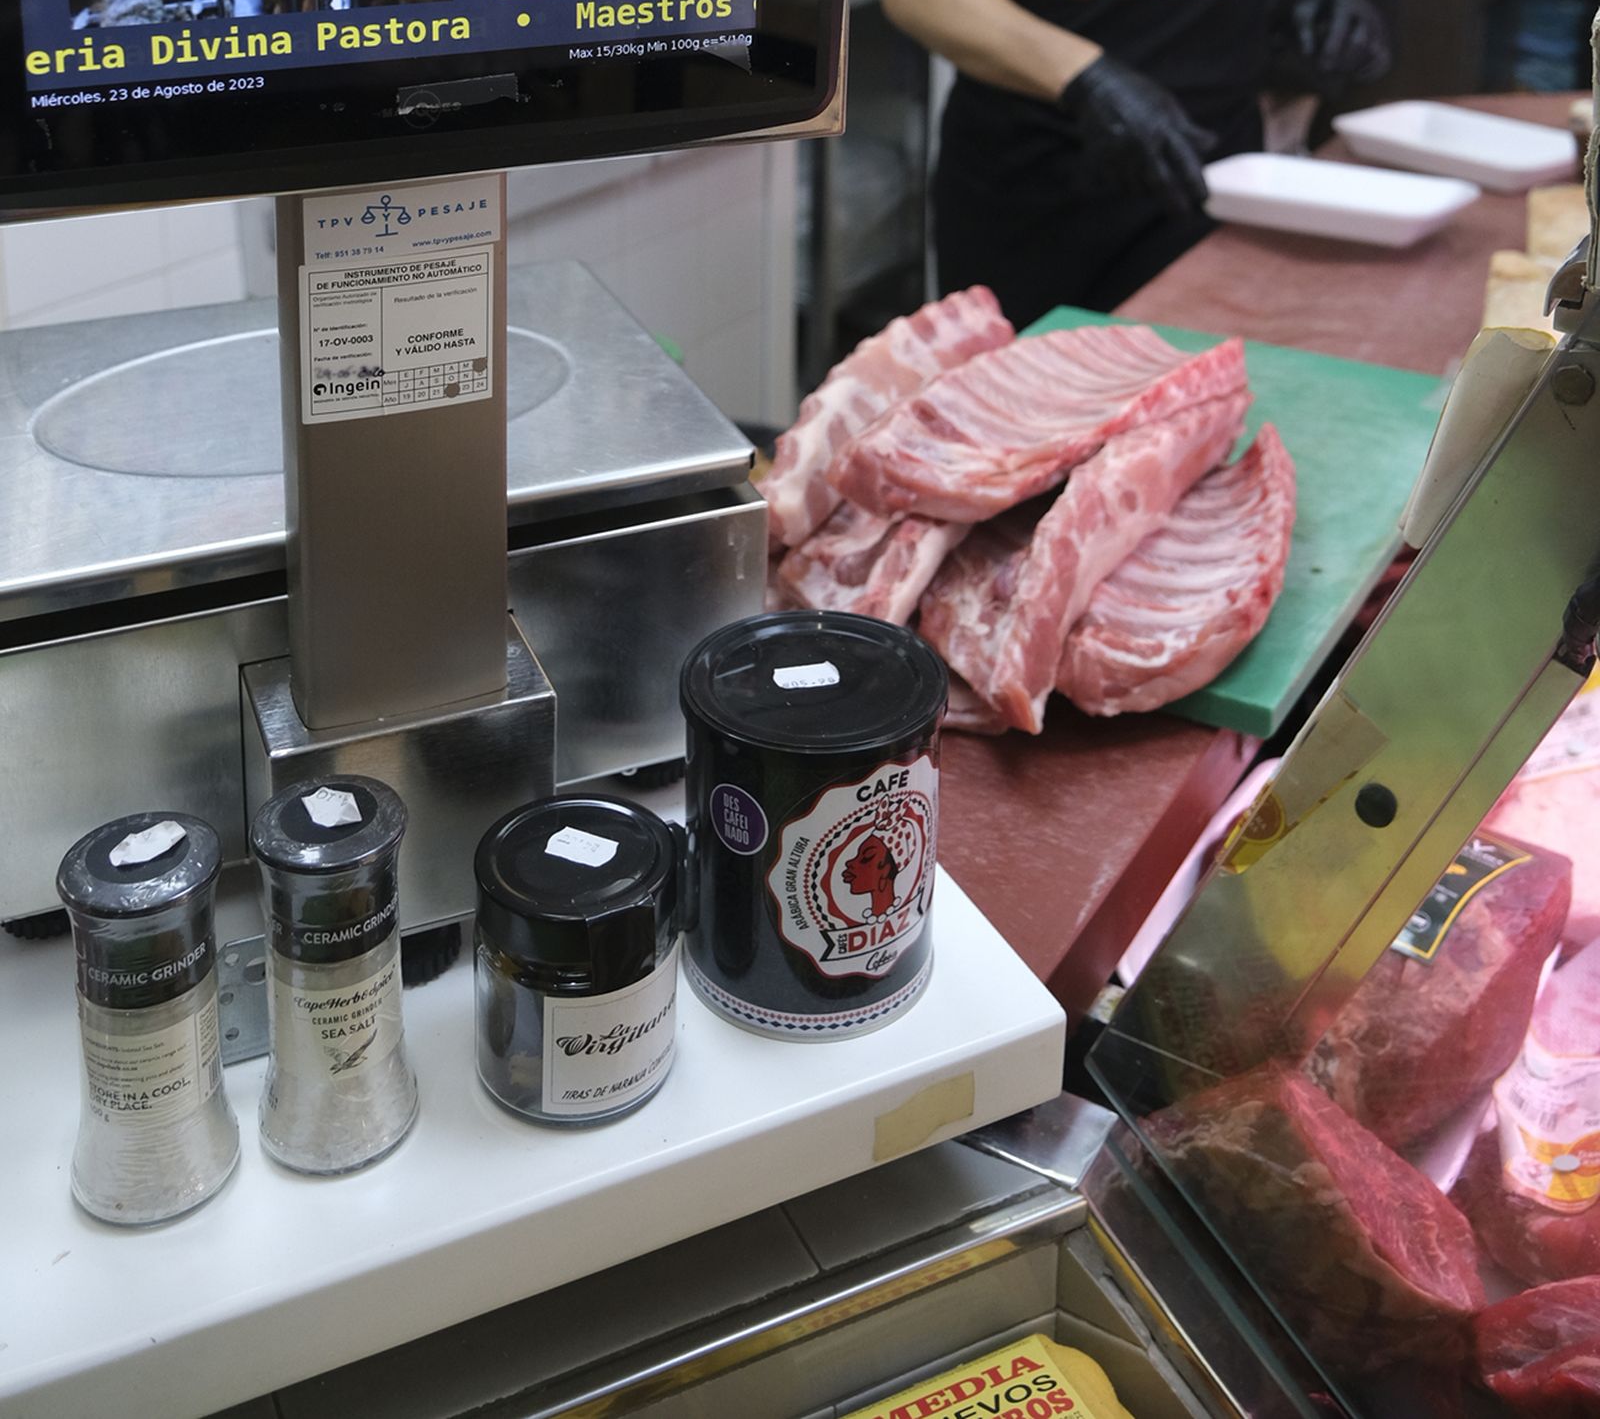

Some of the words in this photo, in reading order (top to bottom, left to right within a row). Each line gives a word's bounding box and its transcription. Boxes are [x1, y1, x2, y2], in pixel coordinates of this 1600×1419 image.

[25, 38, 125, 75] eria
[151, 26, 293, 65] Divina
[316, 15, 470, 51] Pastora
[569, 48, 593, 60] Max
[596, 44, 644, 58] 15/30kg
[647, 42, 667, 53] Min
[671, 38, 700, 51] 100g
[31, 91, 105, 108] Miércoles,
[110, 89, 128, 102] 23
[132, 87, 150, 99] de
[153, 83, 203, 100] Agosto
[207, 80, 225, 92] de
[229, 77, 264, 91] 2023
[318, 217, 353, 229] TPV
[418, 199, 487, 217] PESAJE
[331, 273, 410, 288] FUNCIONAMIENTO
[412, 272, 425, 280] NO
[344, 266, 407, 279] INSTRUMENTO
[410, 264, 421, 272] DE
[424, 260, 457, 270] PESAJE
[319, 334, 374, 347] 17-OV-0003
[395, 348, 402, 356] Y
[443, 337, 476, 349] HASTA
[407, 328, 464, 344] CONFORME
[330, 378, 380, 395] Ingein
[723, 793, 740, 812] DES
[723, 808, 749, 831] CAFEI
[724, 823, 749, 845] NADO
[788, 836, 810, 869] ALTURA
[785, 868, 797, 893] GRAN
[303, 924, 362, 944] CERAMIC
[88, 967, 149, 986] CERAMIC
[152, 942, 206, 981] GRINDER
[312, 1013, 349, 1025] CERAMIC
[351, 999, 383, 1019] GRINDER
[321, 1029, 346, 1040] SEA
[349, 1014, 377, 1033] SALT
[123, 1092, 136, 1101] IN
[140, 1092, 149, 1100] A
[561, 1089, 592, 1100] TIRAS
[593, 1085, 608, 1098] DE
[110, 1100, 152, 1111] PLACE.
[943, 1374, 1057, 1419] EVOS
